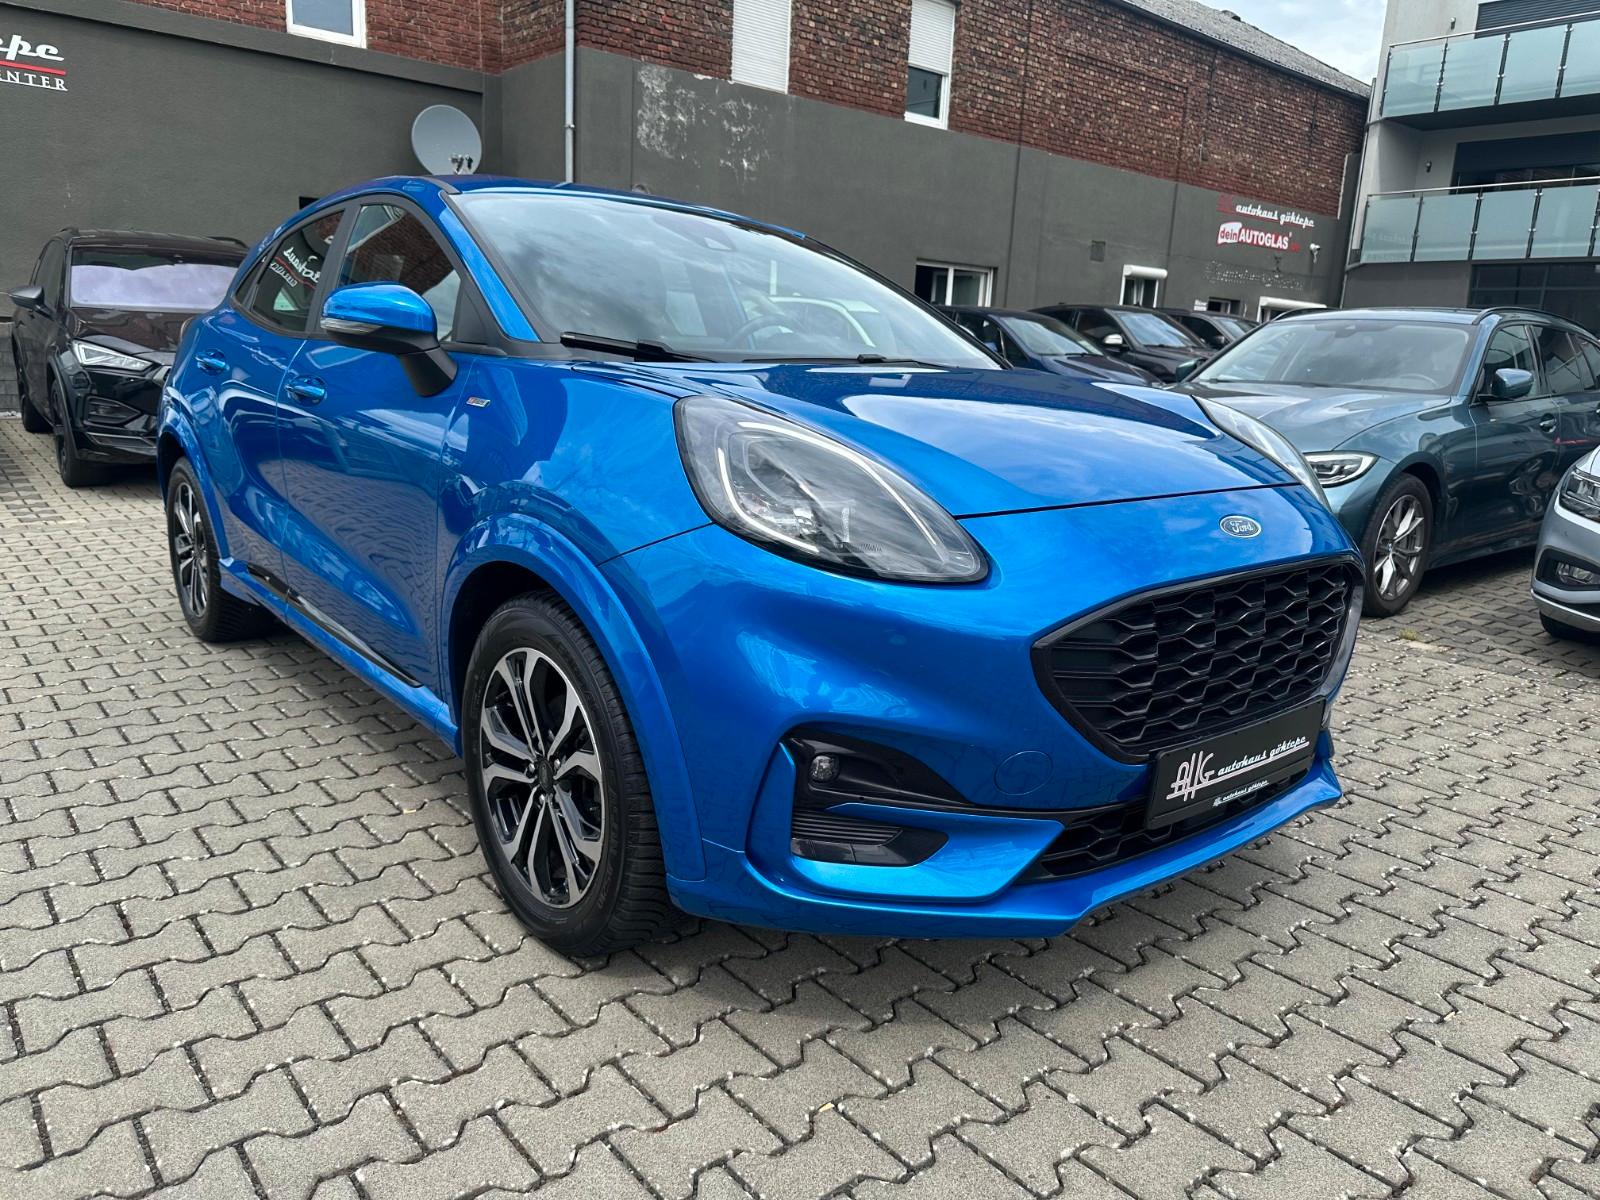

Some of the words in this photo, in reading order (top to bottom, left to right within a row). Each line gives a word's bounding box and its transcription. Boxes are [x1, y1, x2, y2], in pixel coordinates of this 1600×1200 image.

[1236, 204, 1278, 220] autohaus
[1279, 212, 1315, 228] göktepe
[1219, 227, 1238, 241] dein
[1239, 228, 1289, 250] AUTOGLAS
[1229, 520, 1254, 533] Ford
[1217, 750, 1267, 776] autohaus
[1269, 735, 1307, 759] göktepe
